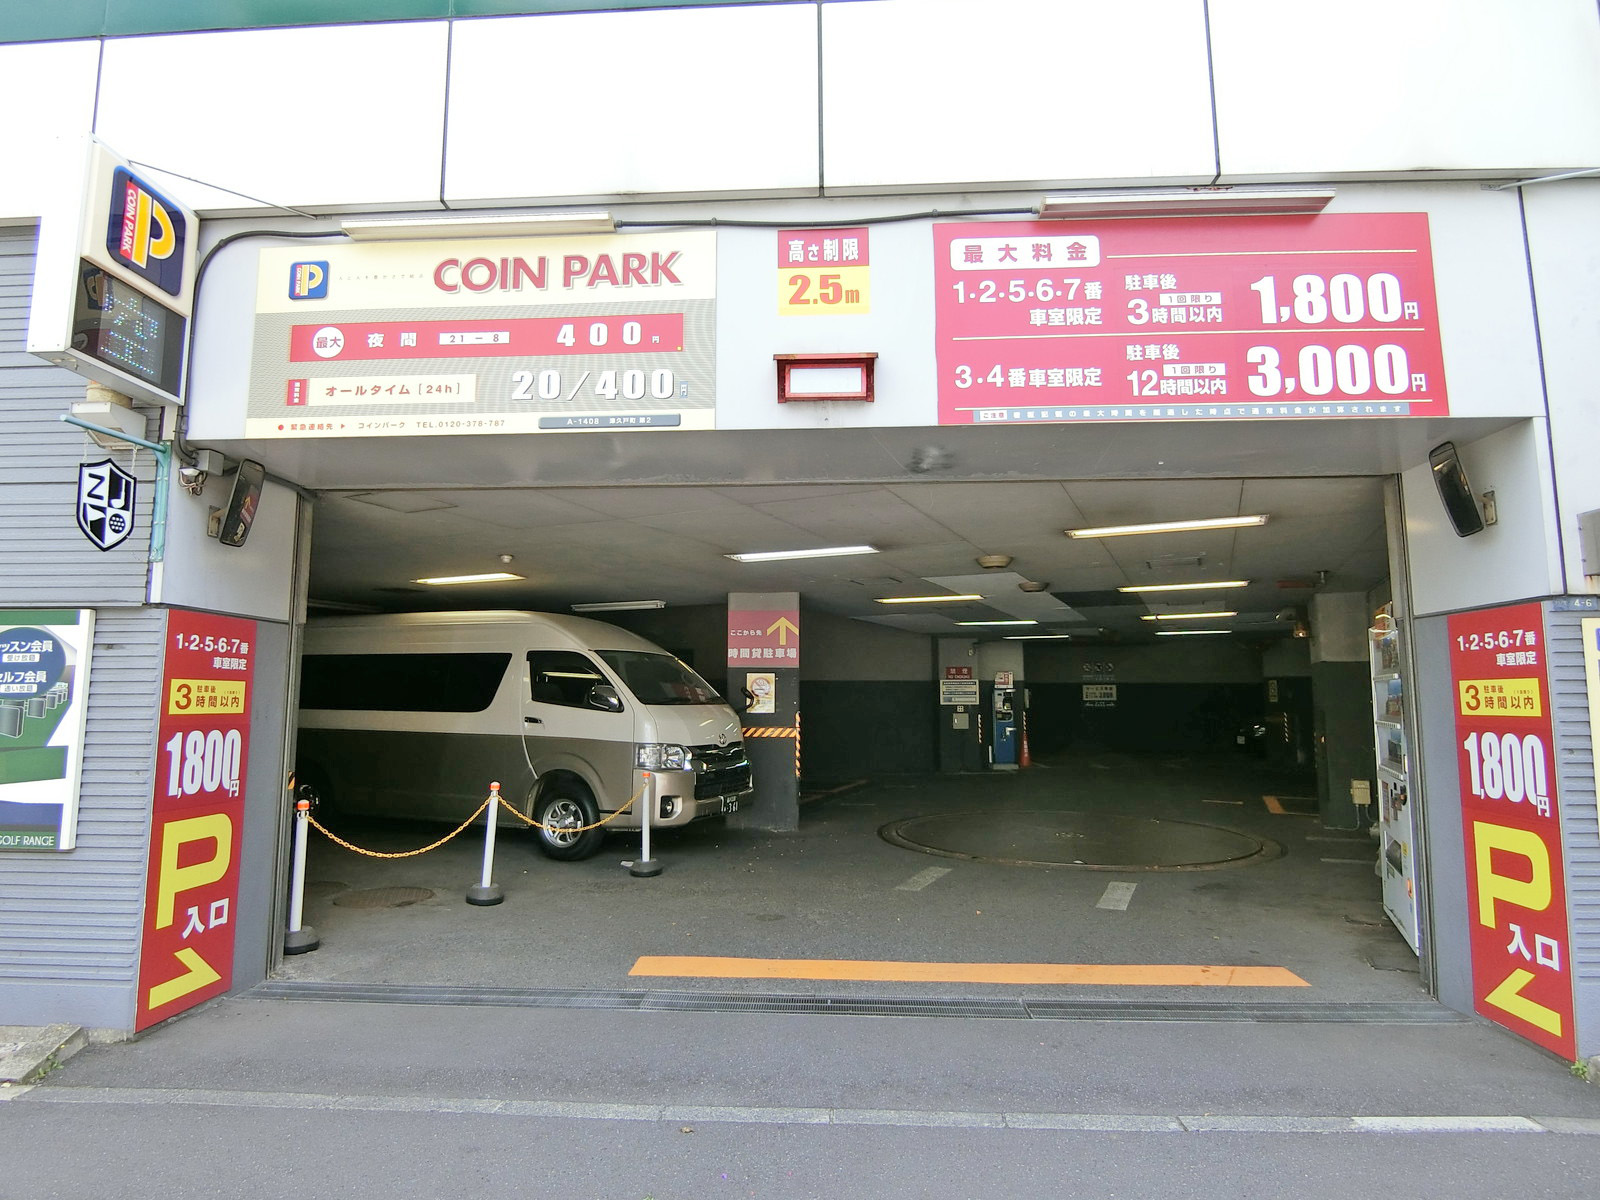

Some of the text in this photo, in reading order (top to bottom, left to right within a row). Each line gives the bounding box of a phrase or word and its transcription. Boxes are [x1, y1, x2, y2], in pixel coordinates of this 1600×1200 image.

[122, 190, 138, 254] COIN PARK
[788, 238, 859, 263] 高さ制限
[963, 242, 1088, 264] 最大料金
[433, 251, 683, 293] COIN PARK
[788, 274, 860, 305] 2.5m
[1124, 273, 1177, 290] 駐車後
[1168, 294, 1213, 304] 1回限り
[1029, 306, 1103, 326] 車室限定
[315, 336, 342, 349] 最大
[367, 332, 417, 348] 夜間
[1126, 344, 1180, 361] 駐車後
[1172, 365, 1217, 375] 1回限り
[358, 421, 406, 429] コインパーク
[566, 417, 600, 425] A-1408
[1574, 598, 1592, 607] 4-6
[730, 629, 763, 637] ここから先
[0, 640, 53, 653] ッスン会員
[728, 648, 797, 659] 時間貸駐車場
[213, 656, 248, 671] 車室限定
[1496, 651, 1537, 667] 車室限定
[196, 685, 217, 694] 駐車後
[1483, 685, 1504, 694] 駐車後
[23, 835, 55, 846] RANGE
[156, 813, 233, 930] P
[1473, 820, 1552, 929] P
[181, 897, 230, 940] 入口
[1507, 922, 1560, 971] 入口
